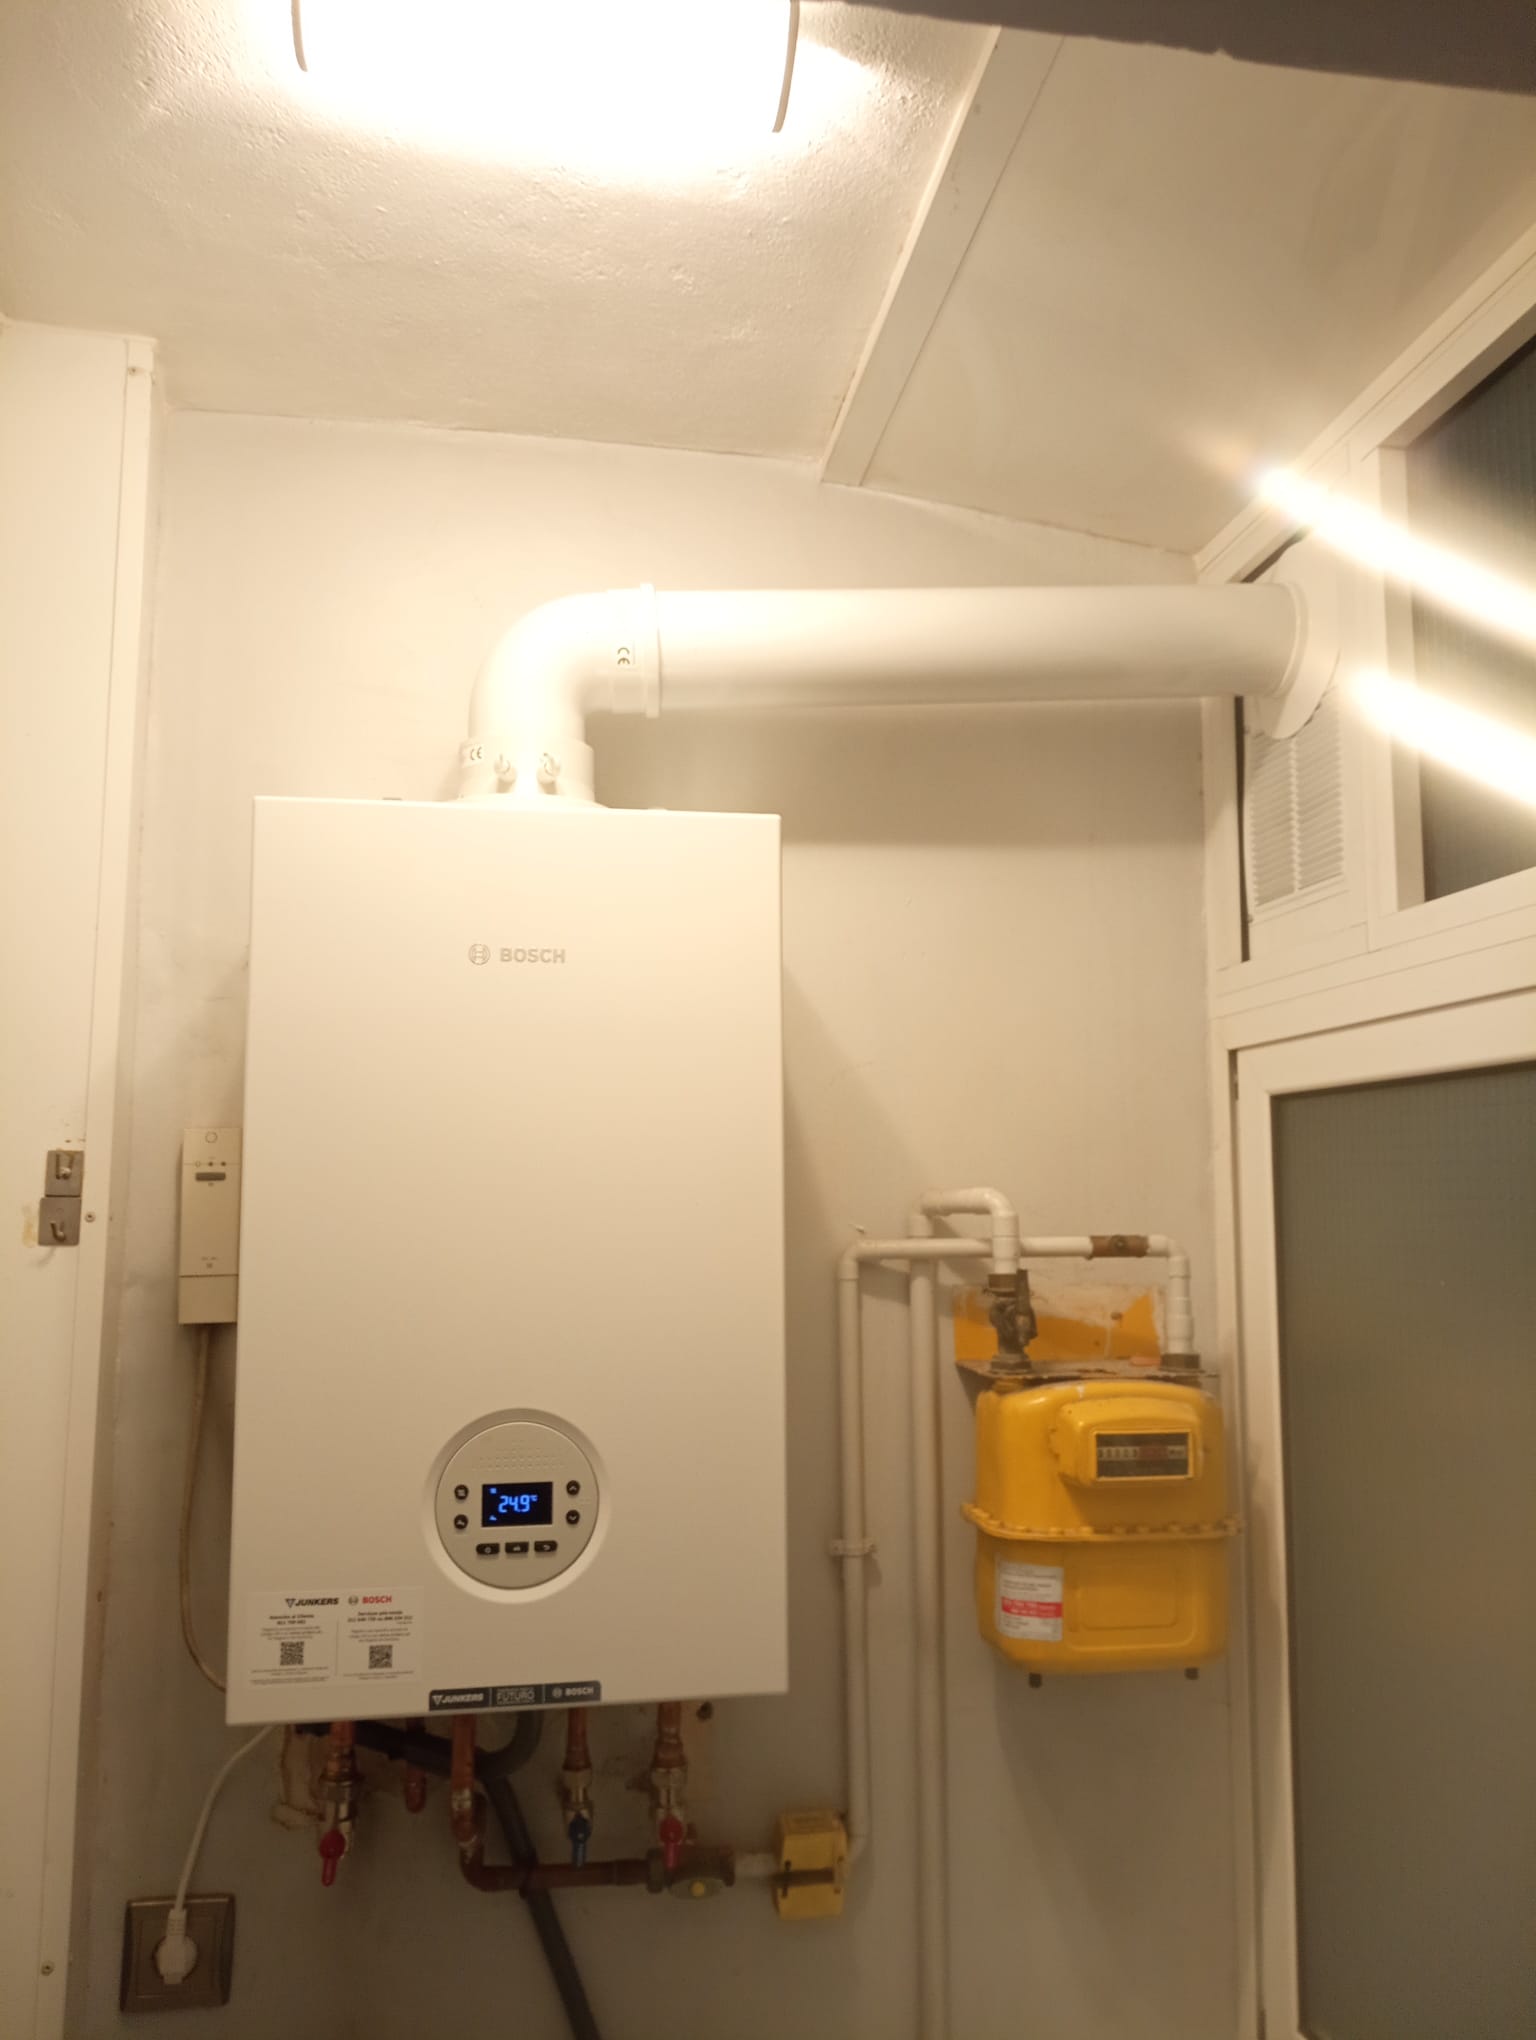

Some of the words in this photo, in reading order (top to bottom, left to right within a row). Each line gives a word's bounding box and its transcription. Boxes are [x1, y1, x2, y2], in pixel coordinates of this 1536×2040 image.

[500, 947, 566, 963] BOSCH
[294, 1597, 340, 1607] JUNKERS
[362, 1595, 393, 1605] BOSCH
[441, 1693, 484, 1704] JUNKERS
[564, 1687, 594, 1697] BOSCH
